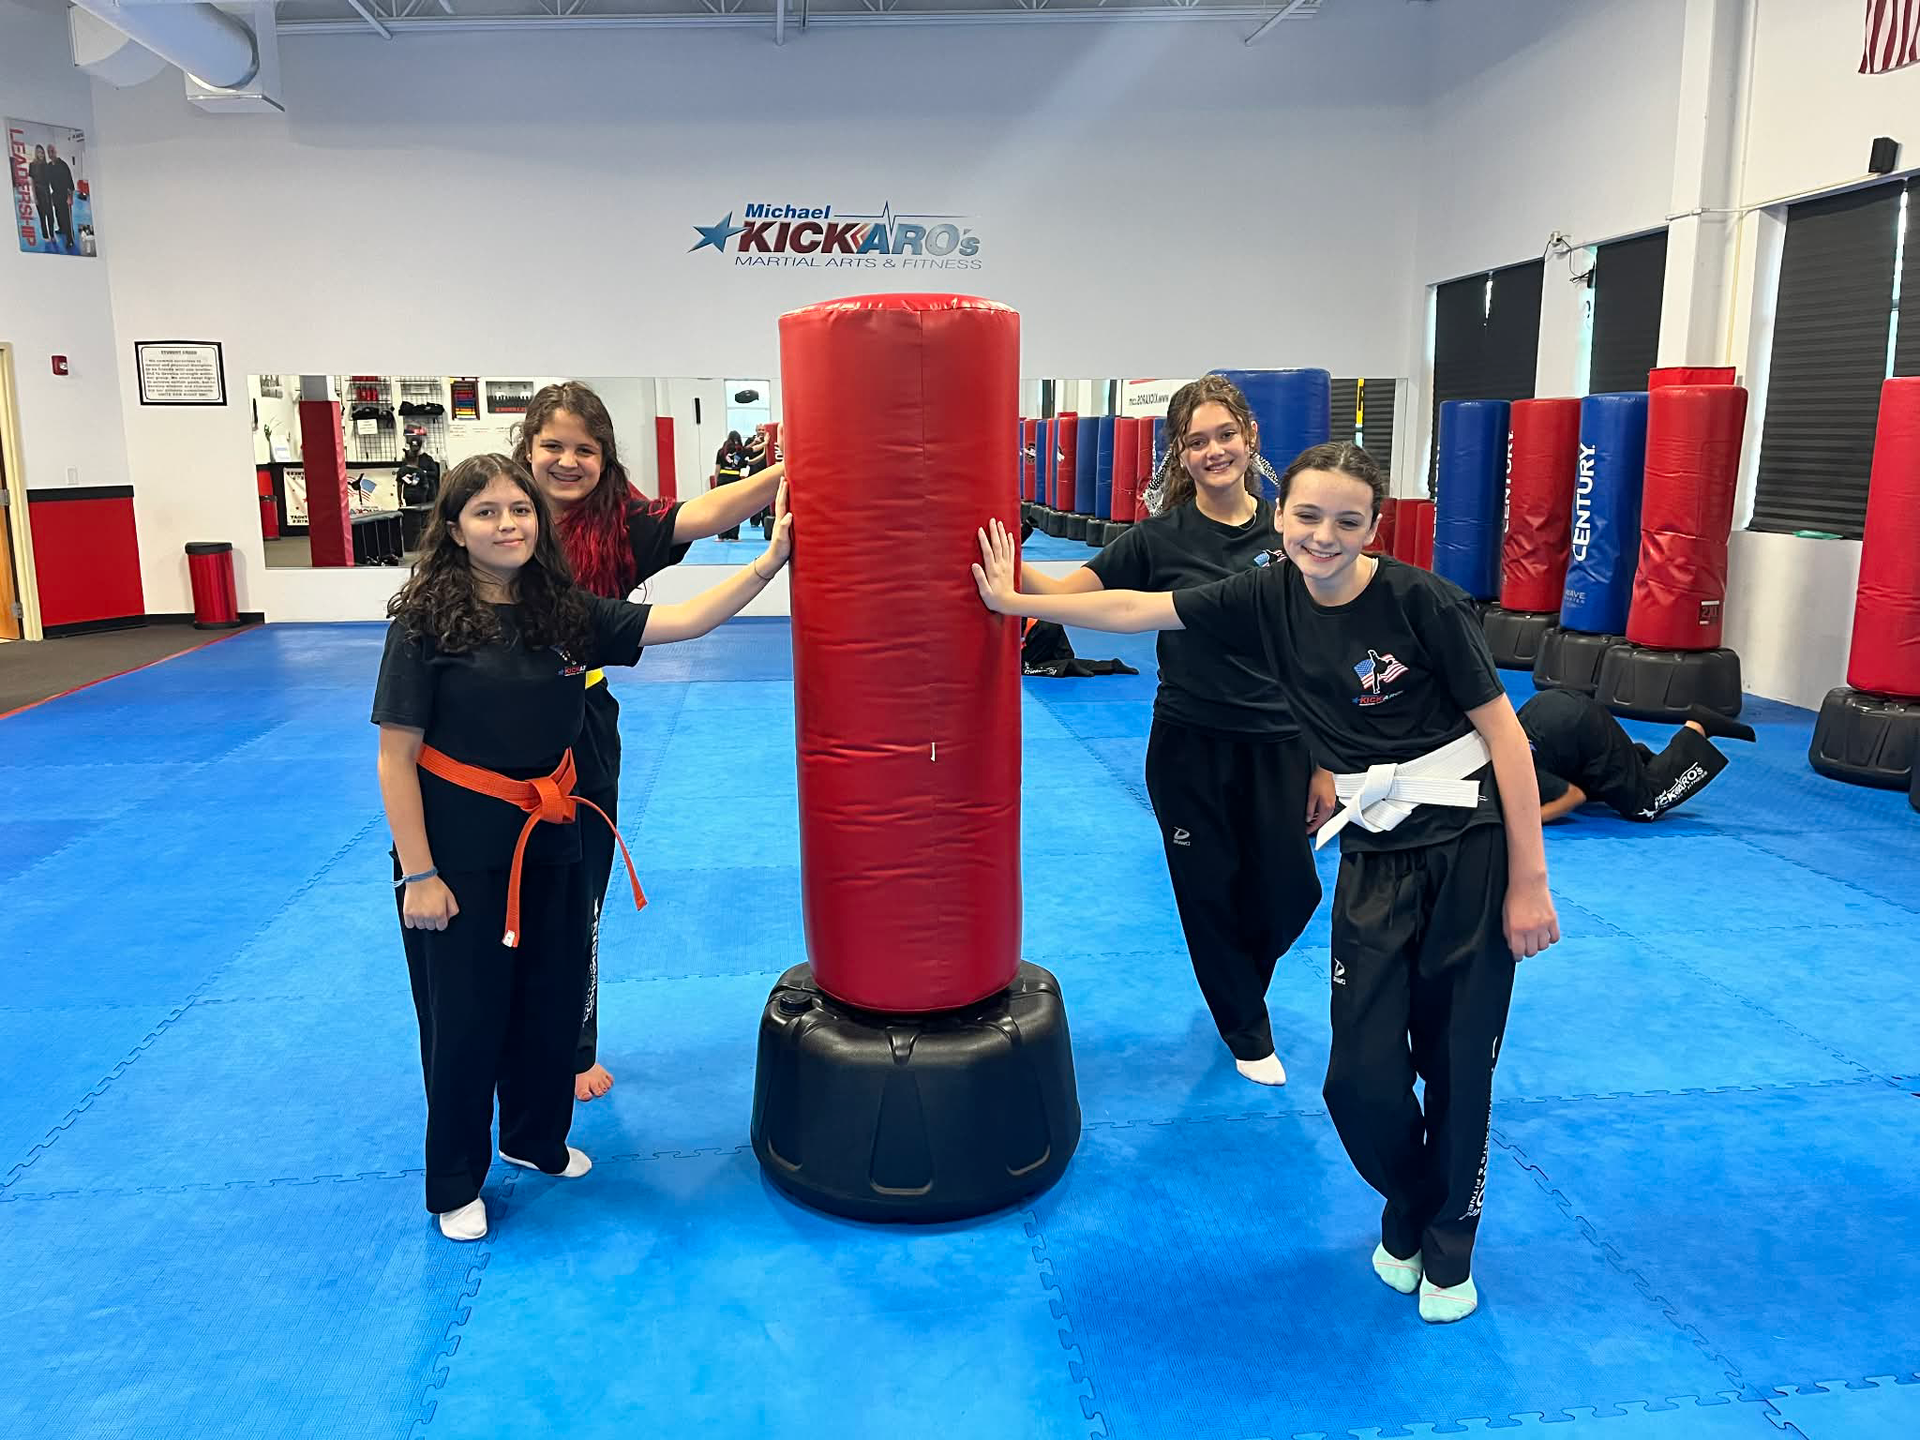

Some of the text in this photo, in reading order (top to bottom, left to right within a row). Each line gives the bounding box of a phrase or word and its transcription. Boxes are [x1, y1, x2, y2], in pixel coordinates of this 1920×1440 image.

[9, 127, 36, 247] LEADERSHIP
[745, 203, 831, 219] Michael
[735, 256, 982, 270] MARTIAL ARTS & FITNESS
